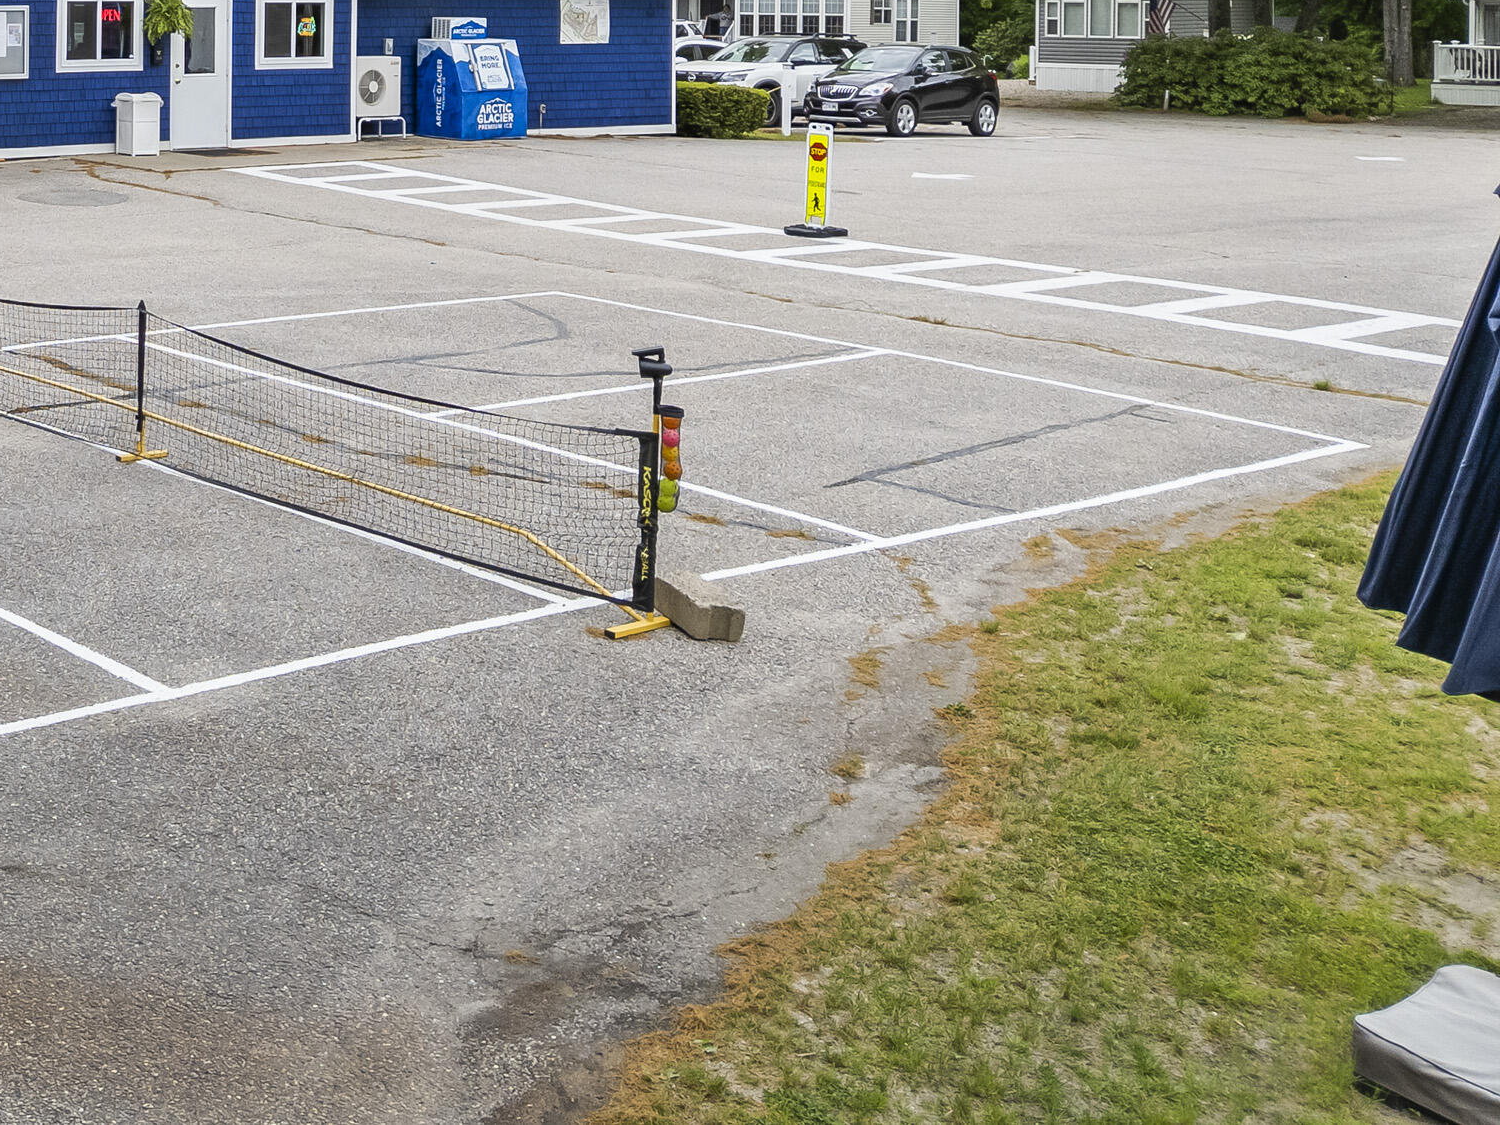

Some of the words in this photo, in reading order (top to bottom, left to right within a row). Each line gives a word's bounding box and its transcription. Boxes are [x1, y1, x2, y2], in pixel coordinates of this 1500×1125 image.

[479, 103, 512, 115] ARCTIC
[477, 113, 514, 124] GLACIER
[478, 123, 503, 131] PREMIUM
[810, 147, 827, 156] STOP
[811, 165, 825, 174] FOR
